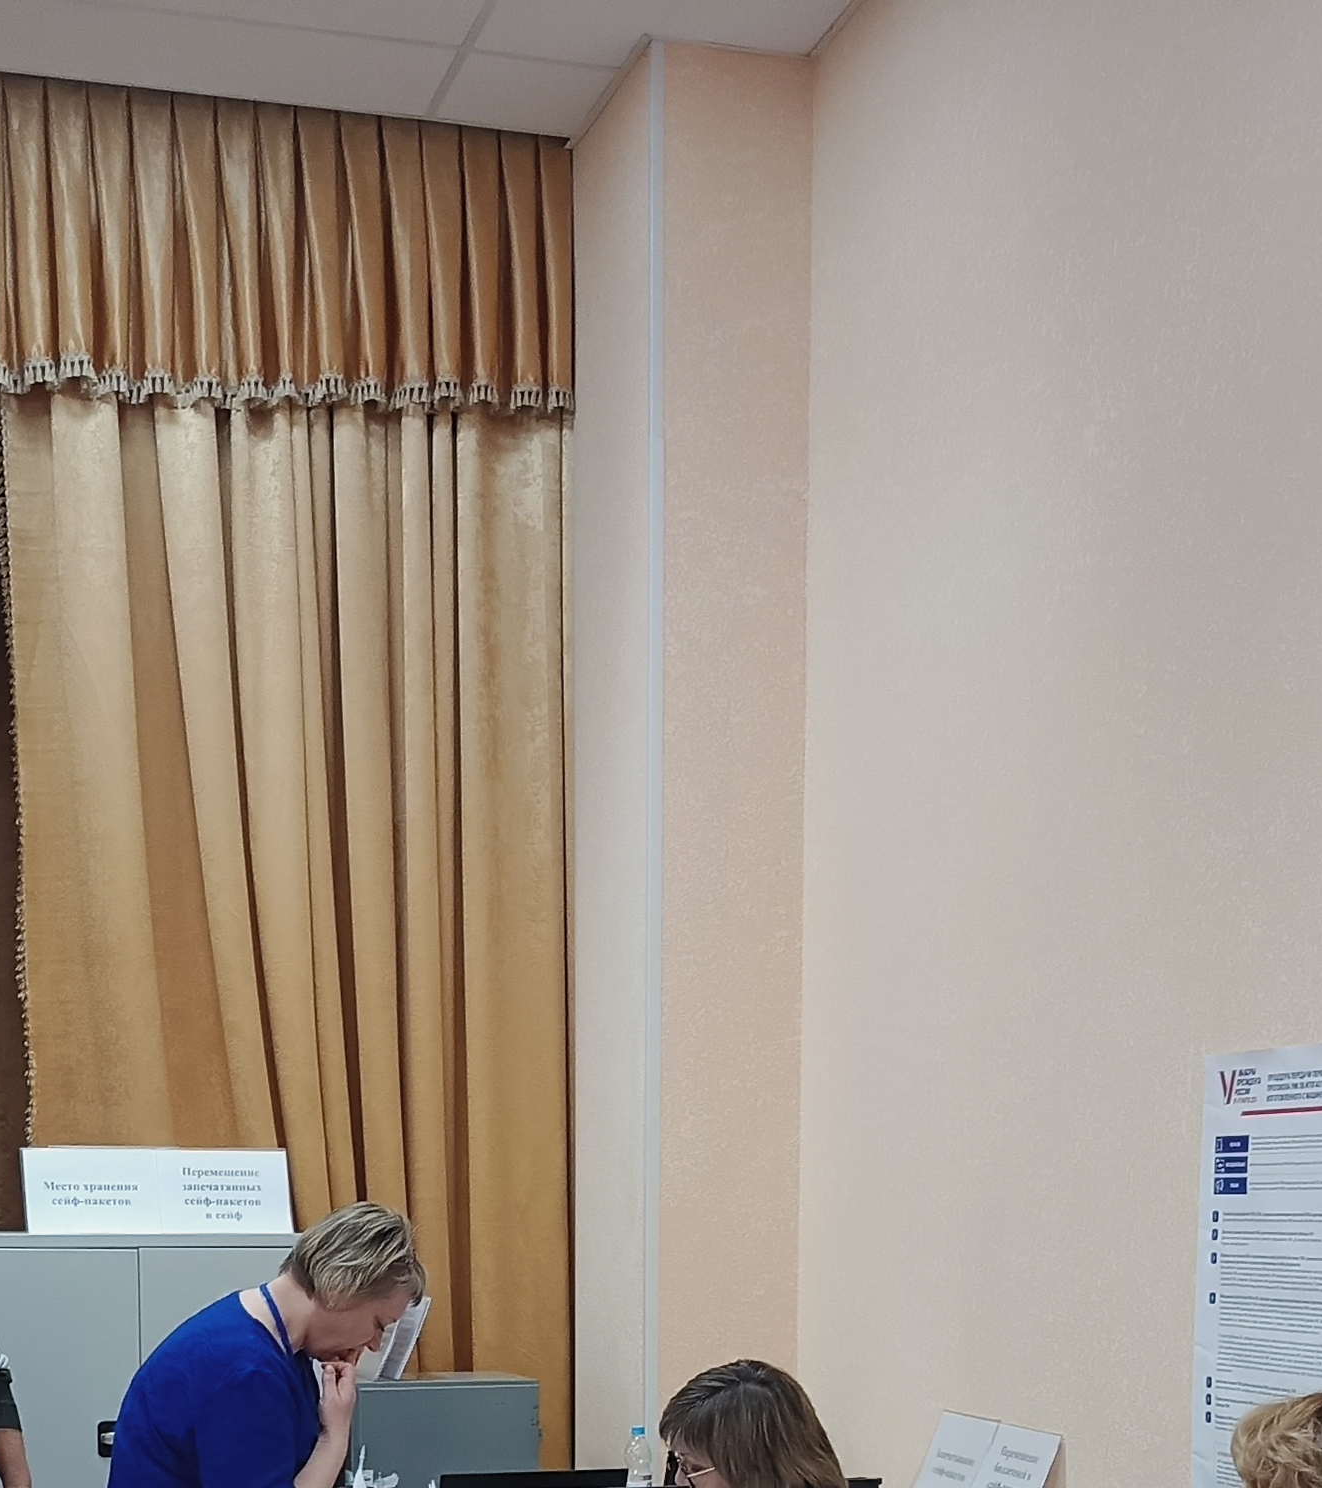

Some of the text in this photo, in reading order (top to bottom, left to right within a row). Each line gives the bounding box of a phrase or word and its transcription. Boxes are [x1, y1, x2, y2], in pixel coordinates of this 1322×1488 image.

[182, 1166, 260, 1179] Перемещение
[43, 1181, 139, 1193] Место хранения
[51, 1196, 132, 1207] сейф-пакетов
[184, 1196, 261, 1207] сейф-пакетов
[215, 1211, 243, 1221] сейф
